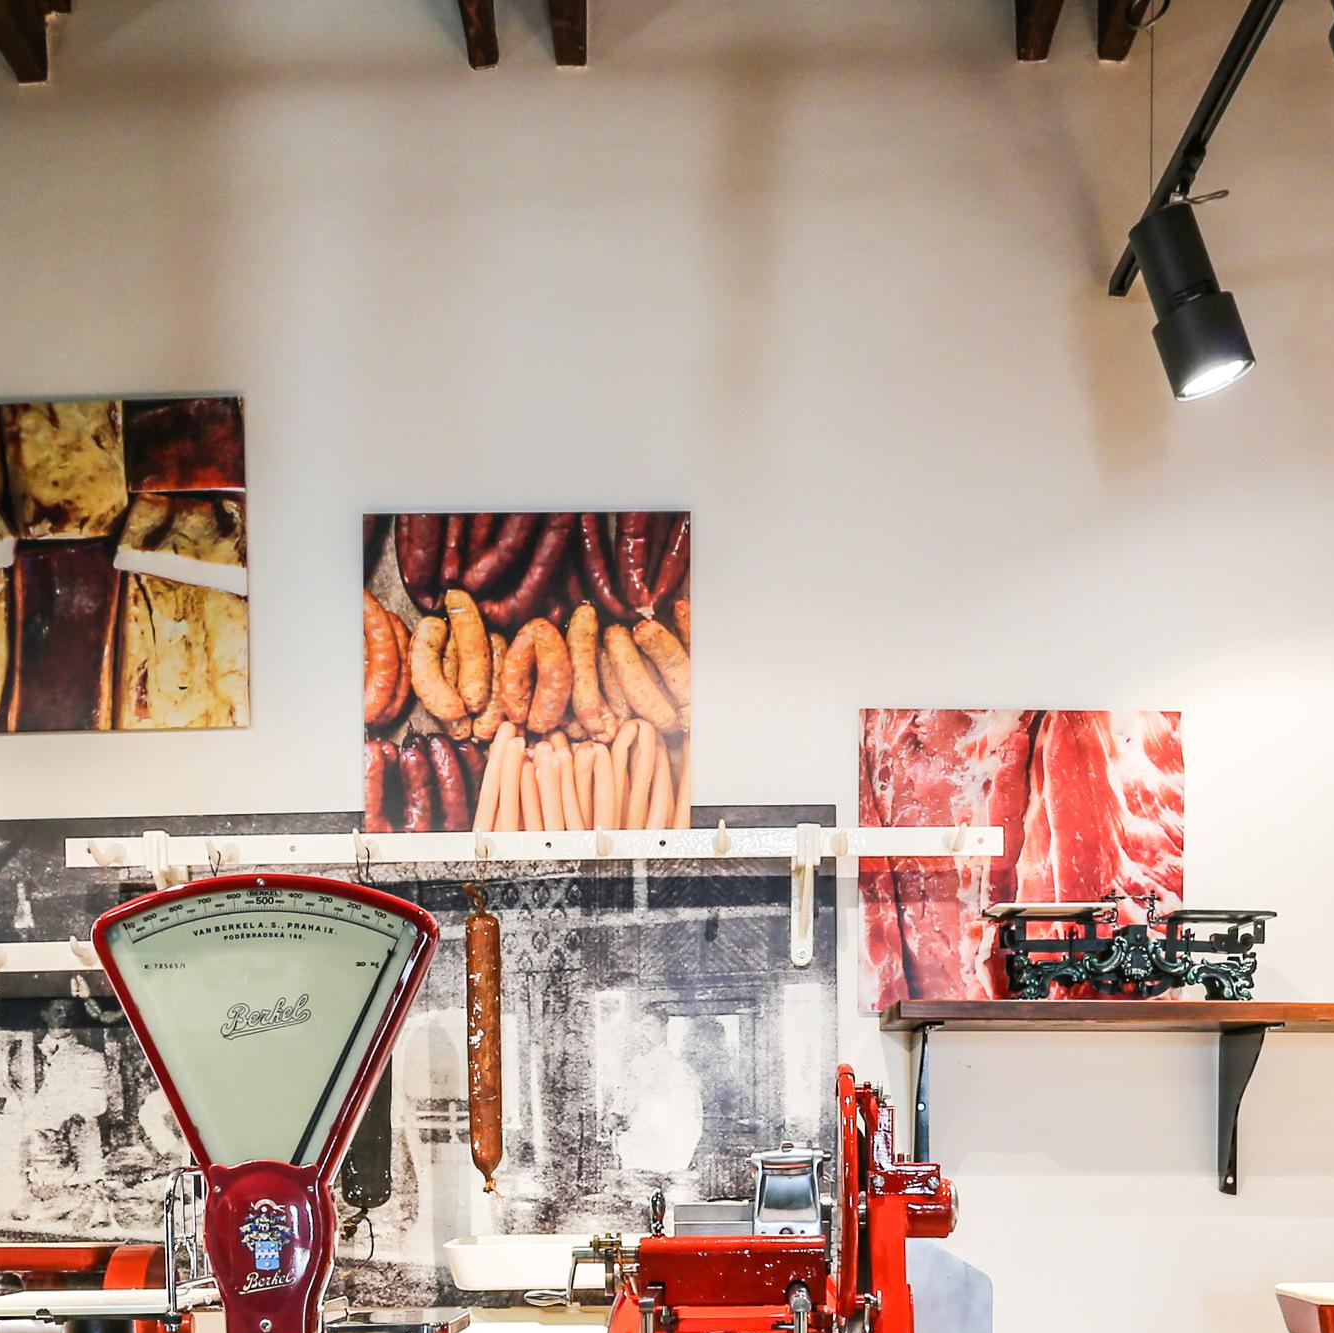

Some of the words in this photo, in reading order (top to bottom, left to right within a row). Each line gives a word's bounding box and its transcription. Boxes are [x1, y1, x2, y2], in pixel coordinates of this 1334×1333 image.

[143, 913, 157, 922] 900
[169, 904, 183, 913] 800
[197, 897, 211, 905] 700
[226, 892, 241, 900] 600
[255, 897, 274, 905] 500
[288, 892, 303, 900] 400
[318, 896, 333, 904] 300
[346, 902, 362, 911] 200
[373, 910, 387, 920] 100
[193, 928, 212, 936] VAN
[214, 922, 255, 932] BERKEL
[287, 922, 322, 932] PRAHA
[323, 927, 338, 936] IX.
[221, 994, 311, 1040] Berkel
[239, 1269, 297, 1295] Berkel
